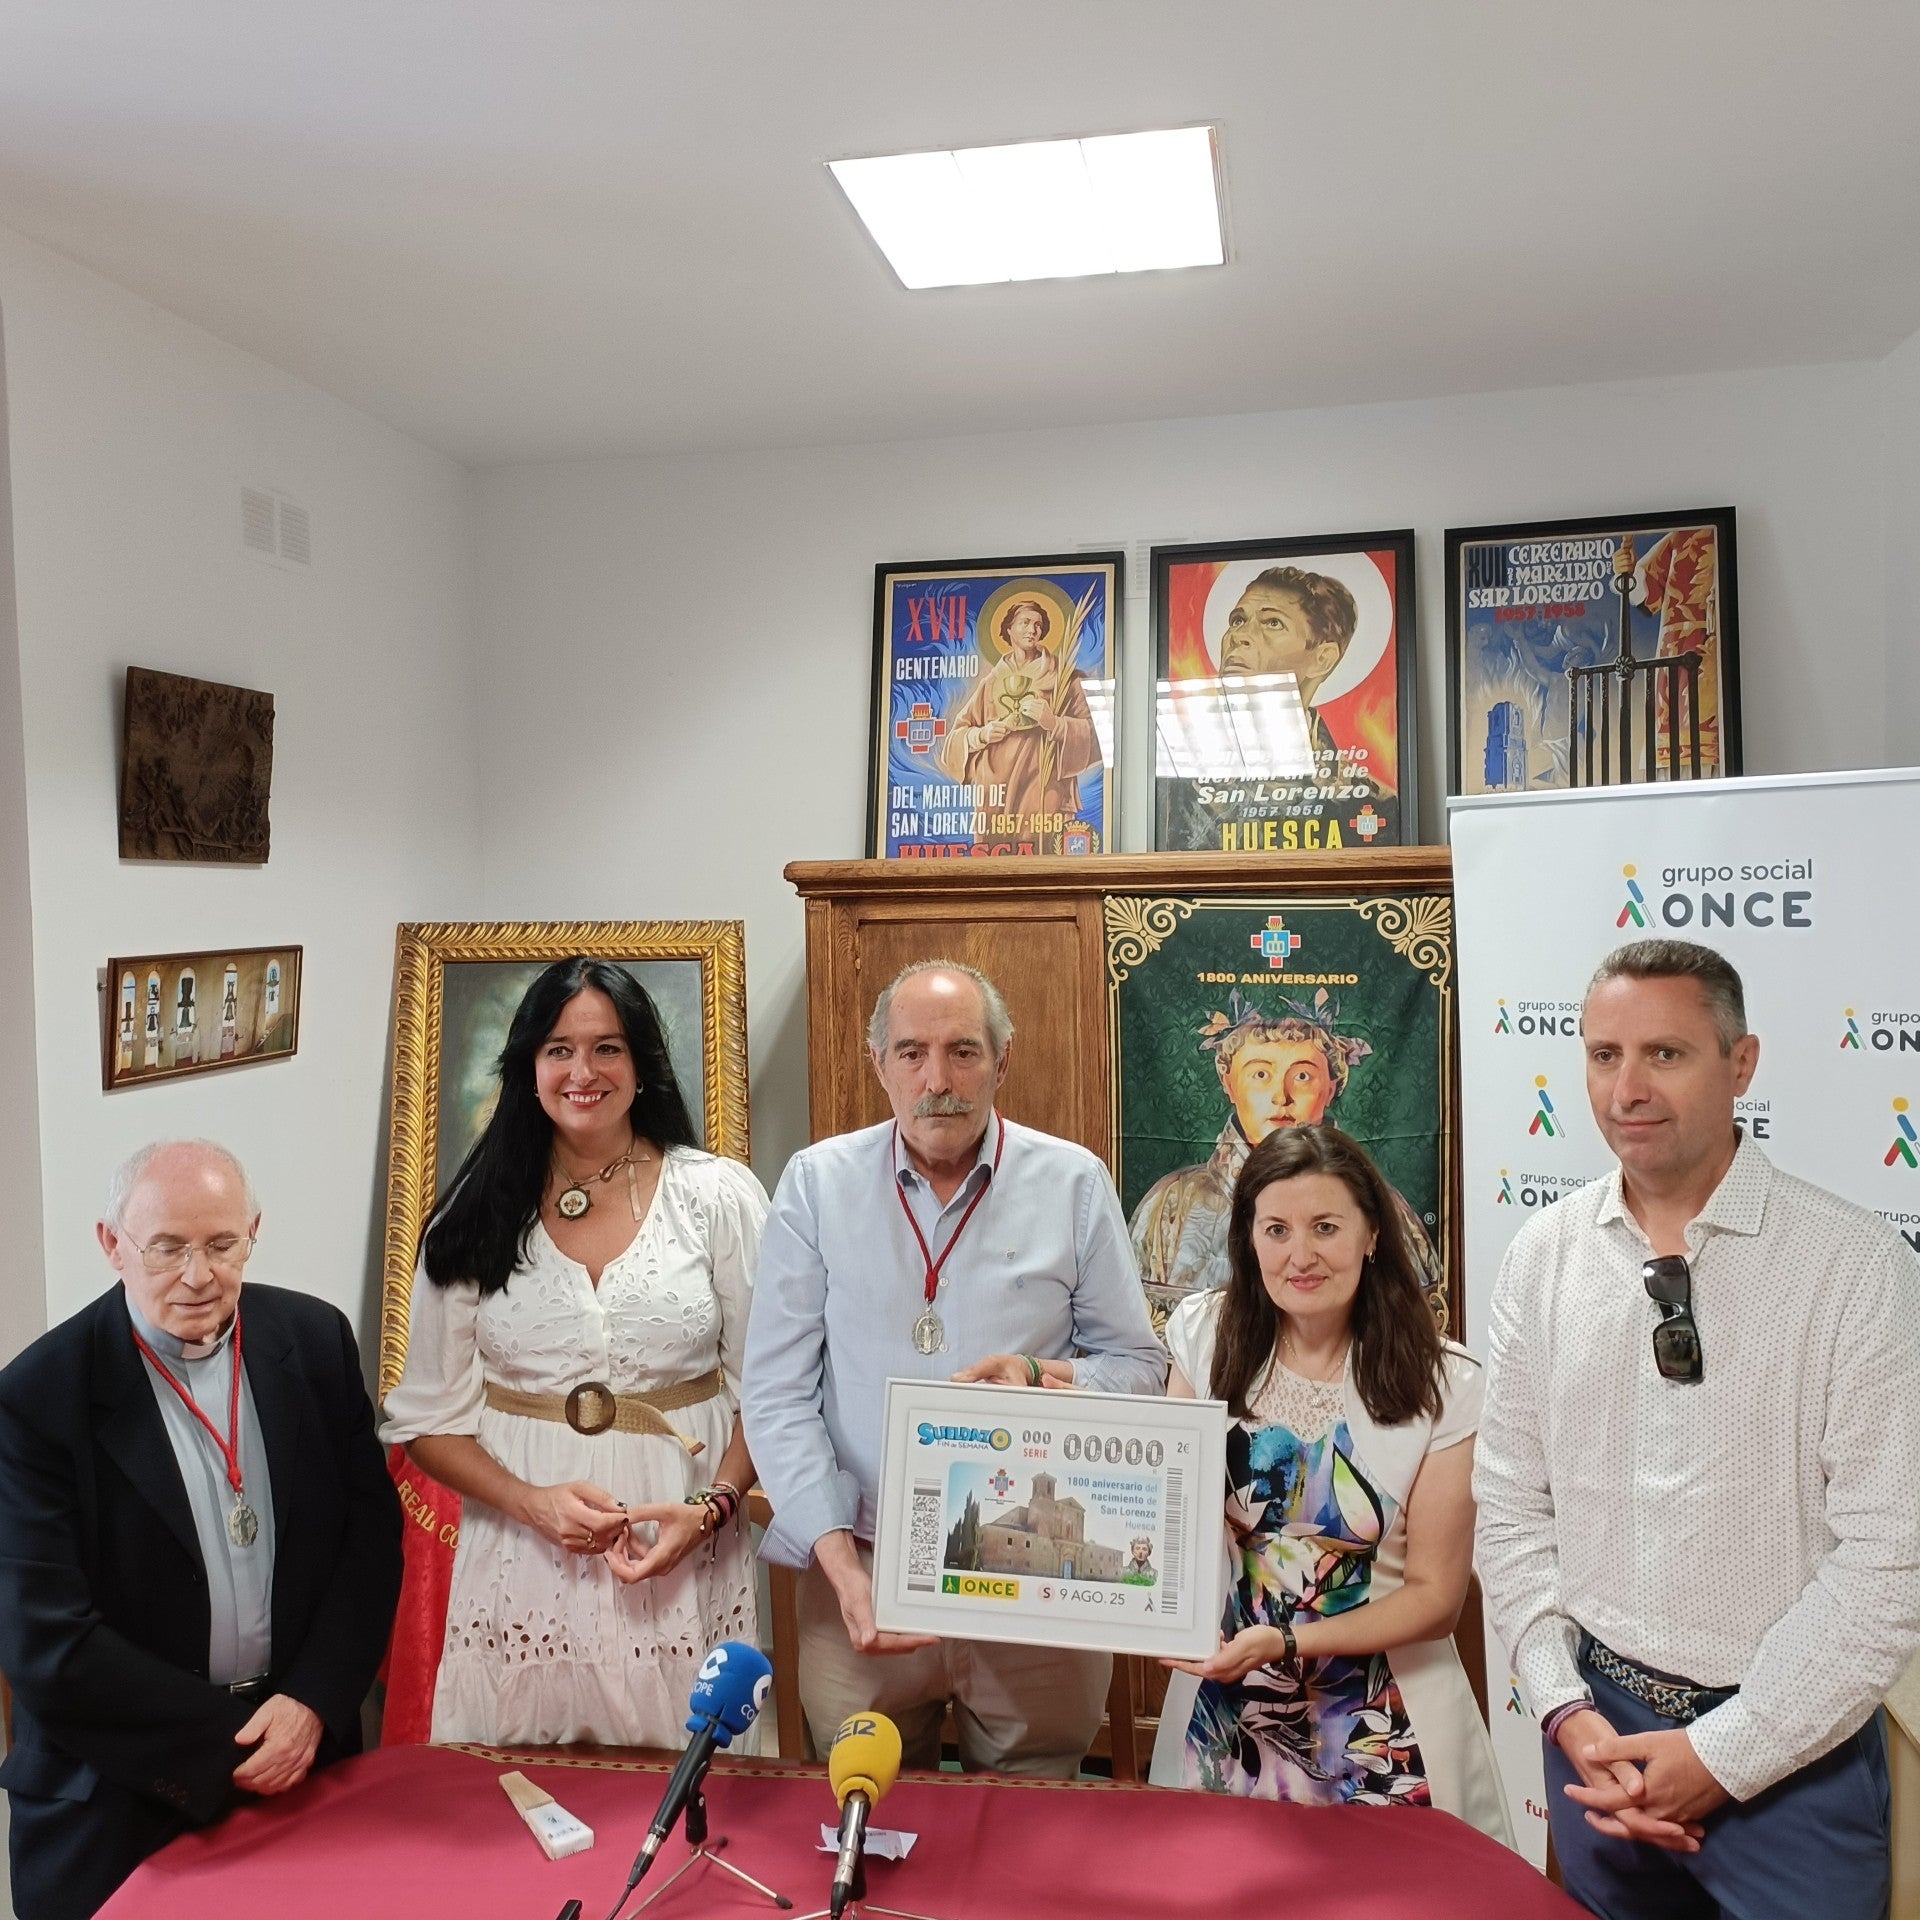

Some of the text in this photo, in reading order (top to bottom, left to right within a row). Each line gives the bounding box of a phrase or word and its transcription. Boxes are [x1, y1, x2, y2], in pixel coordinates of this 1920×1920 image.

[1508, 538, 1615, 565] CENTENARIO
[1515, 560, 1606, 586] MARTIRIO
[1468, 581, 1604, 609] SAN LORENZO
[906, 595, 967, 642] XVII
[896, 654, 979, 681] CENTENARIO
[1342, 762, 1369, 779] de
[893, 783, 1006, 810] DEL MARTIRIO DE
[1197, 783, 1370, 804] San Lorenzo
[1285, 803, 1325, 817] 1958
[891, 813, 919, 838] SAN
[923, 811, 990, 837] LORENZO,
[1222, 819, 1343, 851] HUESCA
[1662, 858, 1812, 888] grupo social
[1662, 891, 1812, 928] ONCE
[1197, 972, 1359, 985] 1800 ANIVERSARIO
[1518, 1000, 1583, 1013] grupo soci
[1871, 1012, 1920, 1026] grupo
[1871, 1028, 1920, 1053] ON
[1735, 1099, 1770, 1112] ocial
[1520, 1173, 1558, 1187] grupo
[1520, 1187, 1572, 1208] ON
[1022, 1430, 1052, 1445] 000
[1023, 1448, 1048, 1459] SERIE
[1063, 1433, 1164, 1468] 00000
[1068, 1477, 1158, 1493] 1800 aniversario del
[397, 1479, 436, 1532] REAL
[1091, 1492, 1157, 1506] nacimiento de
[1100, 1505, 1157, 1519] San Lorenzo
[1125, 1519, 1156, 1532] Huesca
[963, 1579, 1015, 1597] ONCE
[1043, 1587, 1051, 1599] S
[1059, 1588, 1068, 1600] 9
[1109, 1592, 1126, 1606] 25
[691, 1681, 714, 1697] OPE
[831, 1719, 877, 1748] ER
